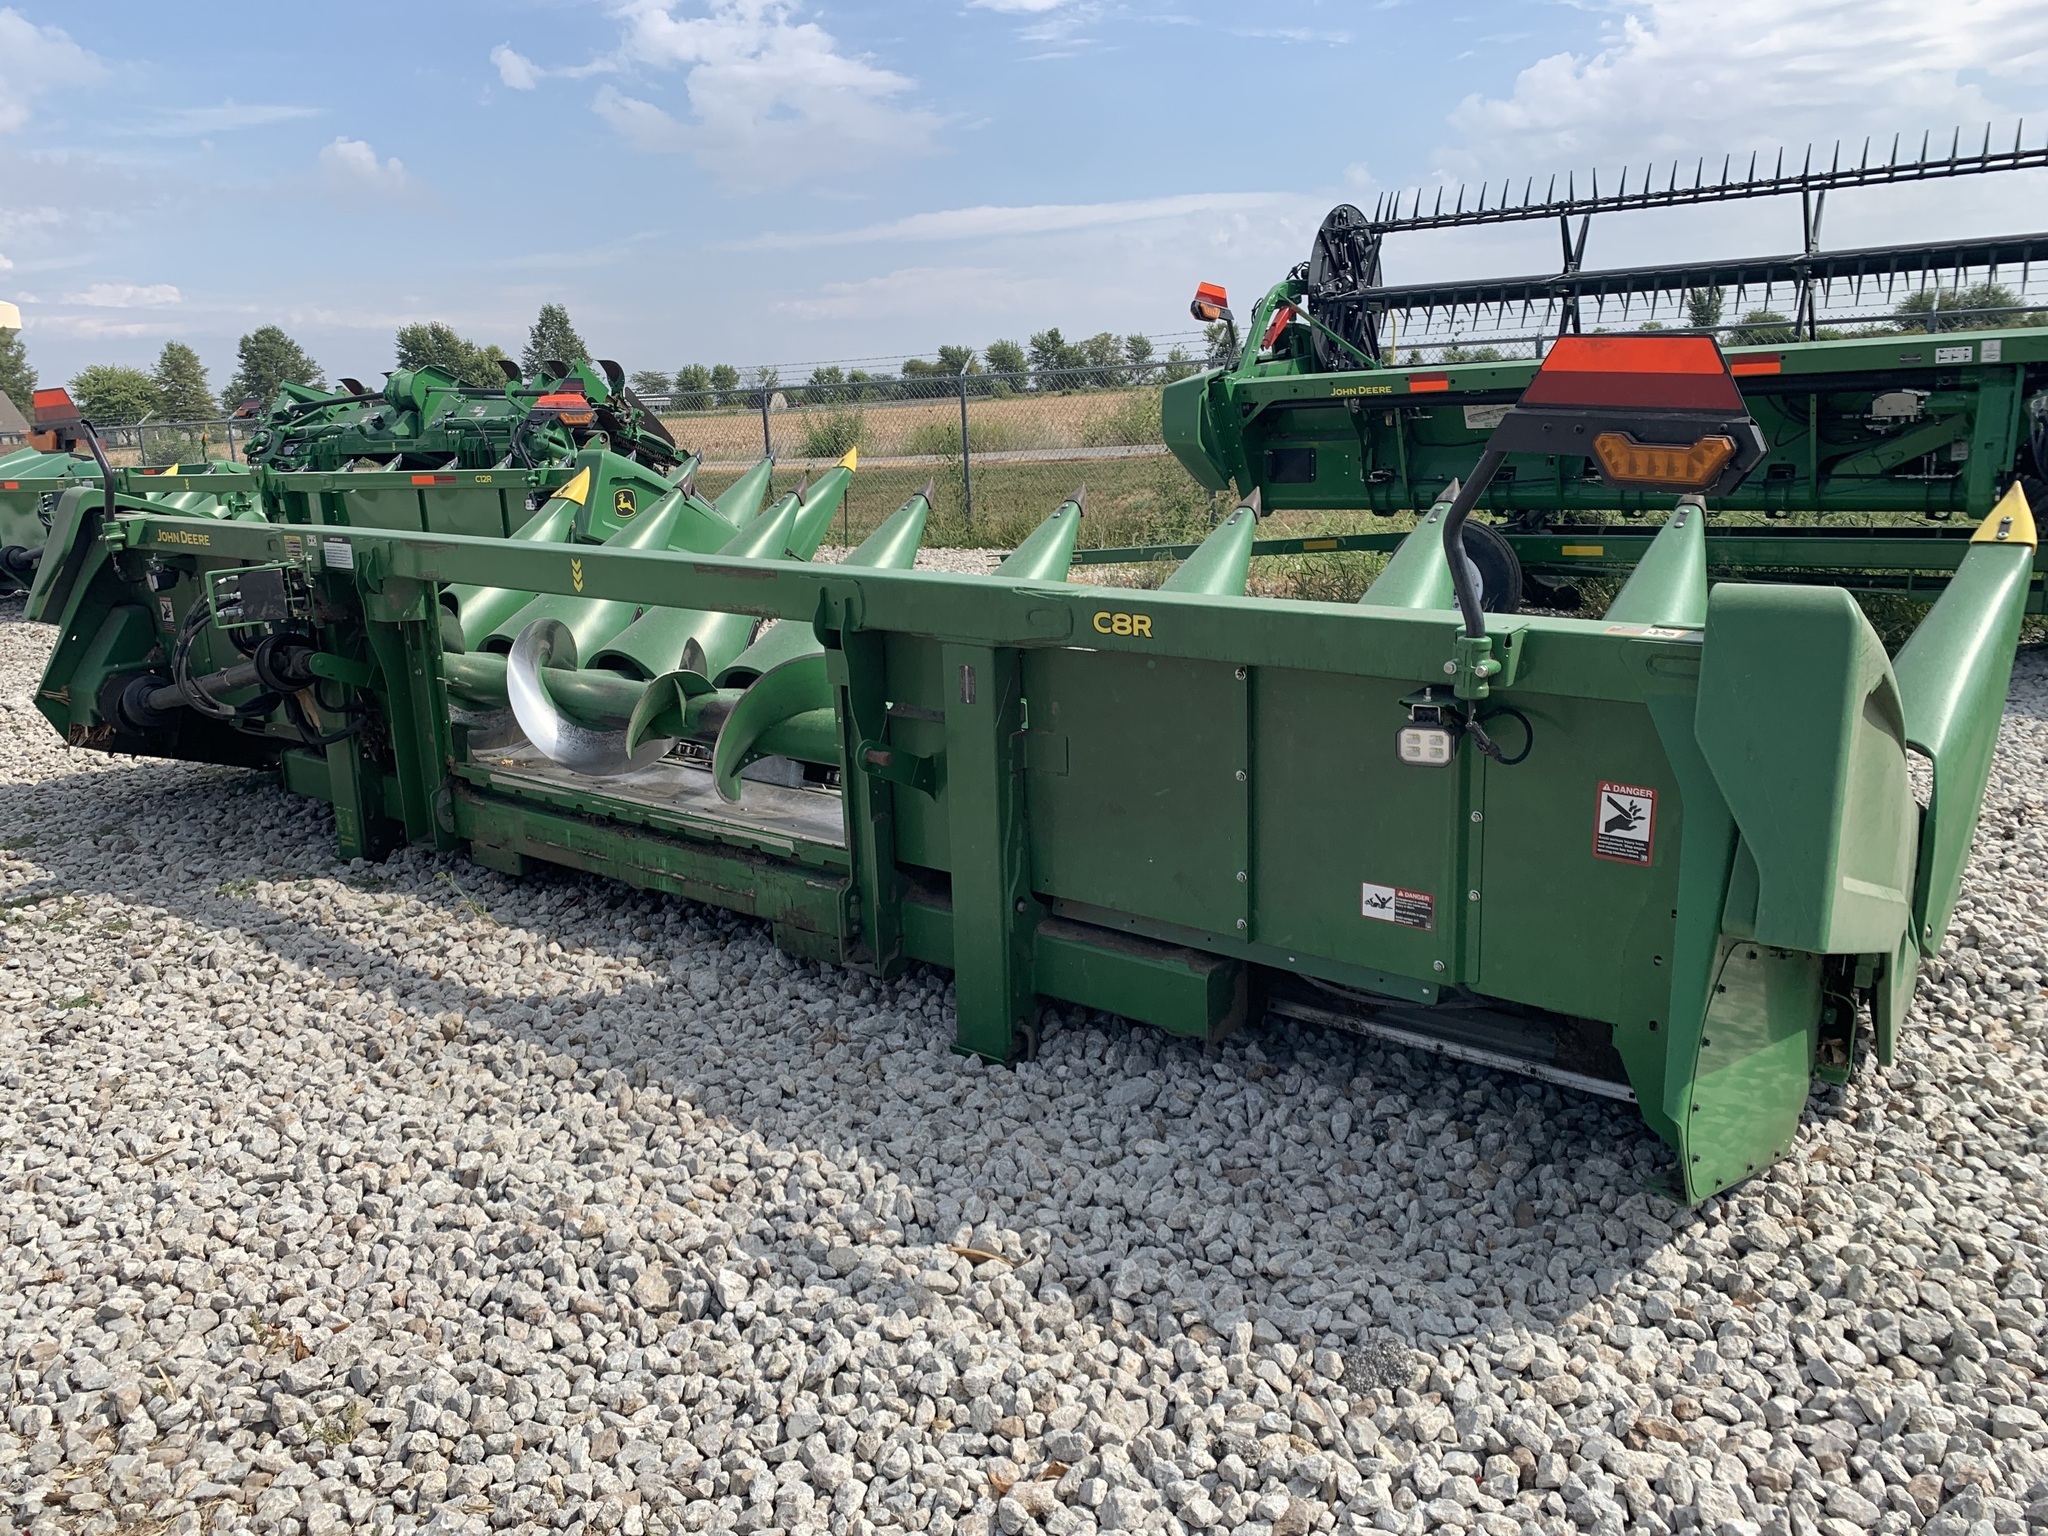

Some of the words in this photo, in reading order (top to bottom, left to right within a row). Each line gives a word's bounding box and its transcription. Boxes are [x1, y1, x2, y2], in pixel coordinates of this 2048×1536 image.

[1331, 387, 1357, 396] JOHN
[1358, 385, 1392, 395] DEERE
[475, 475, 492, 483] C12R
[157, 529, 180, 543] JOHN
[180, 530, 211, 546] DEERE
[1093, 611, 1153, 638] C8R
[1613, 784, 1653, 798] DANGER
[1404, 892, 1430, 902] DANGER
